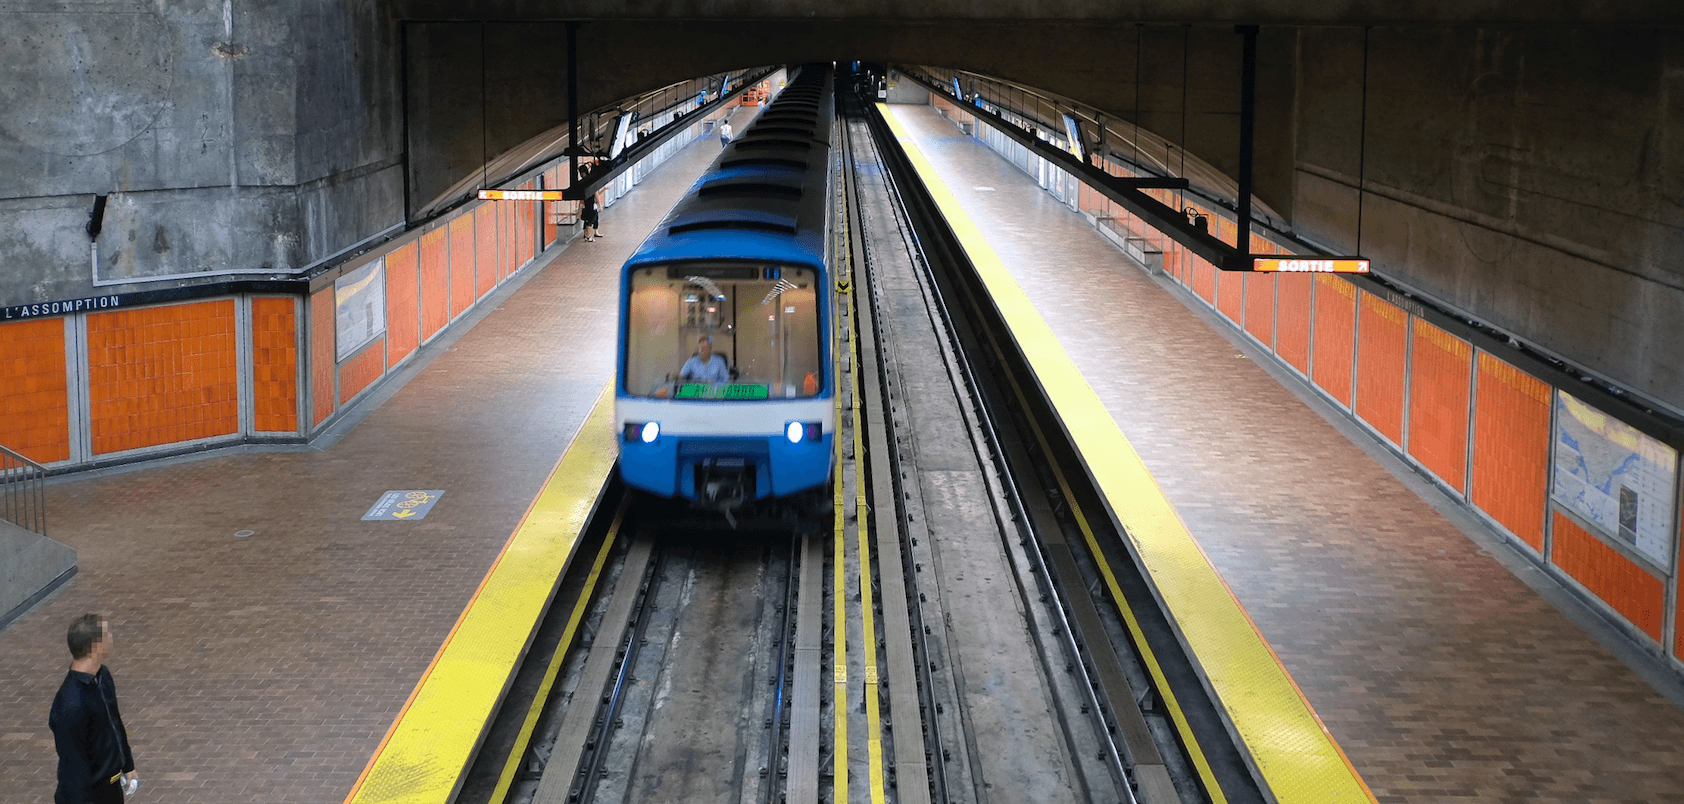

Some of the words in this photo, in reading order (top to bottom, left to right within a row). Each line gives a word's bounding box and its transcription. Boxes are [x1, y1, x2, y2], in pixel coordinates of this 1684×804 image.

[503, 190, 543, 200] SORTIE
[1278, 260, 1334, 272] SORTIE
[5, 295, 119, 319] L'ASSOMPTION
